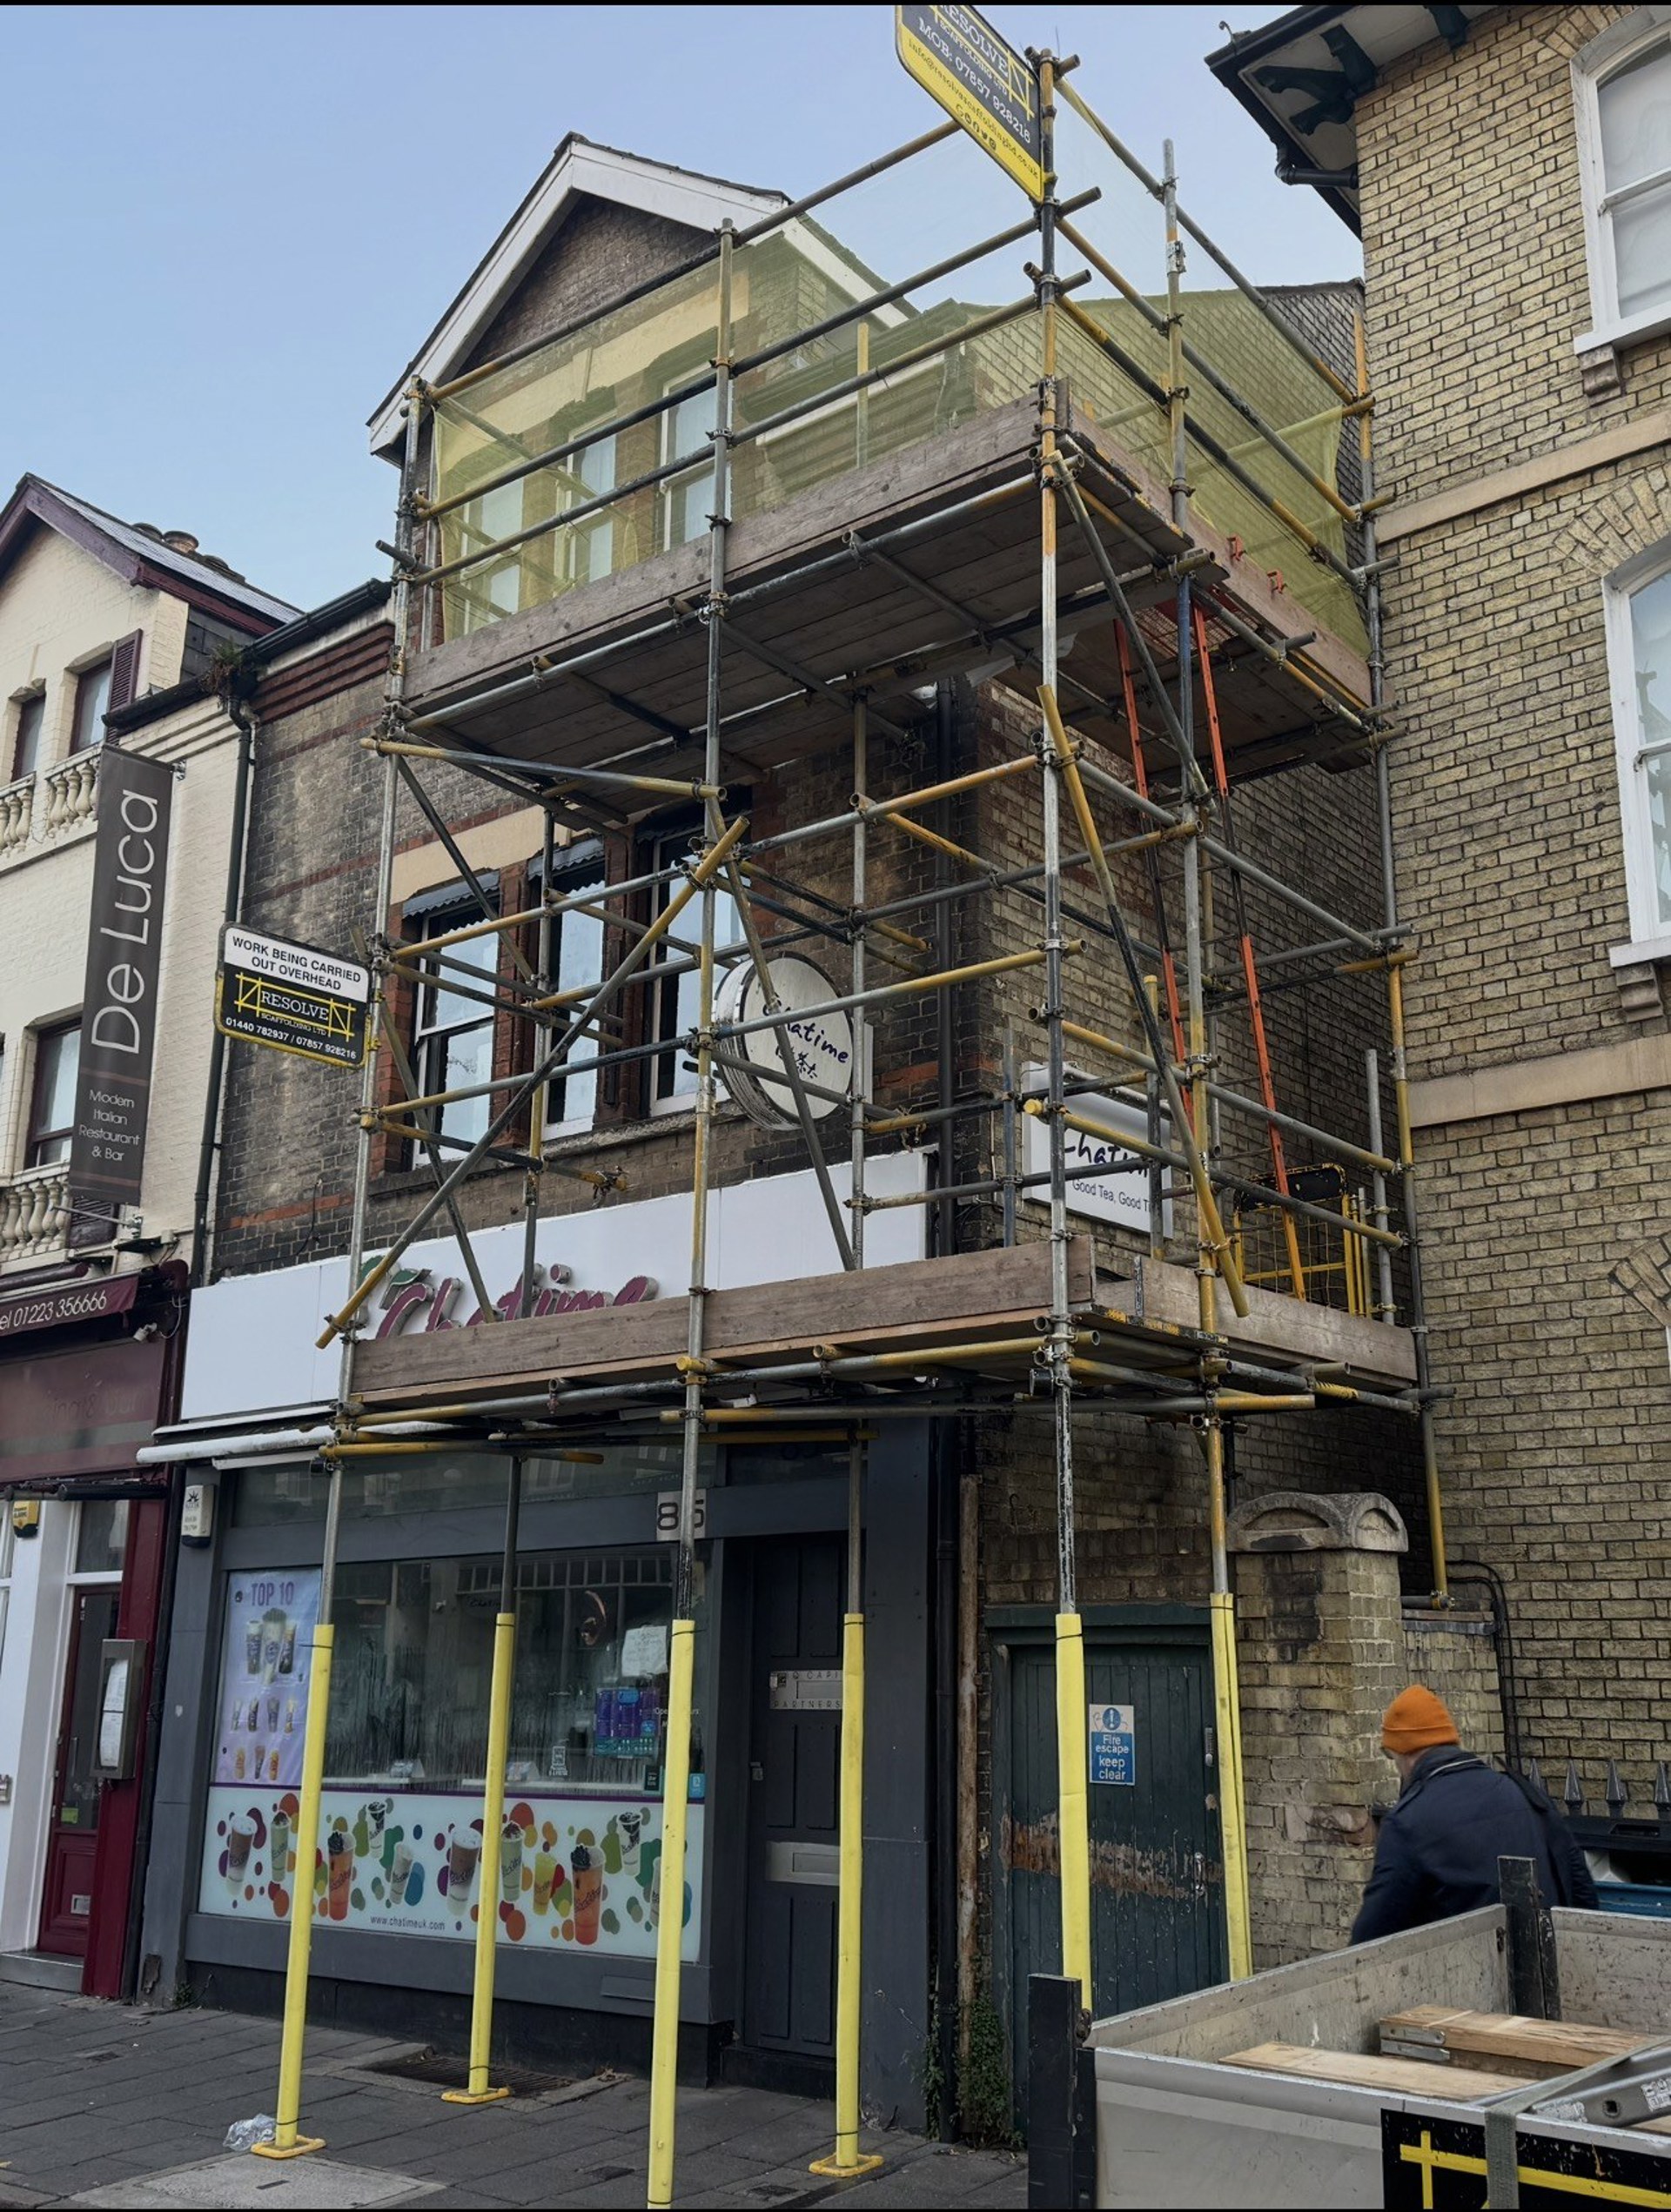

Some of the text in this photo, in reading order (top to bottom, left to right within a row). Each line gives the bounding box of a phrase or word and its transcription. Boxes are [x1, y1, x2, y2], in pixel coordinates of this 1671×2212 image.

[919, 17, 952, 61] MOB:
[956, 56, 990, 98] 07857
[91, 789, 158, 1055] De Luca
[232, 935, 361, 983] WORK BEING CARRIED
[252, 956, 341, 990] OUT OVERHEAD
[261, 990, 329, 1022] RESOLVE
[225, 1016, 254, 1032] 01440
[257, 1024, 289, 1042] 782937
[296, 1036, 323, 1049] 07857
[261, 1013, 327, 1036] SCAFFOLDING LTD
[89, 1089, 135, 1109] Modern
[93, 1108, 128, 1125] Italian
[78, 1123, 141, 1146] Restaurant
[91, 1145, 124, 1162] & Bar
[1072, 1179, 1097, 1196] Good
[1118, 1191, 1142, 1210] Good
[0, 1290, 107, 1330] el 01223 356666
[251, 1581, 295, 1606] TOP 10
[1096, 1745, 1130, 1756] escape
[1103, 1734, 1122, 1745] Fire
[1099, 1755, 1125, 1770] keep
[1099, 1768, 1126, 1780] clear
